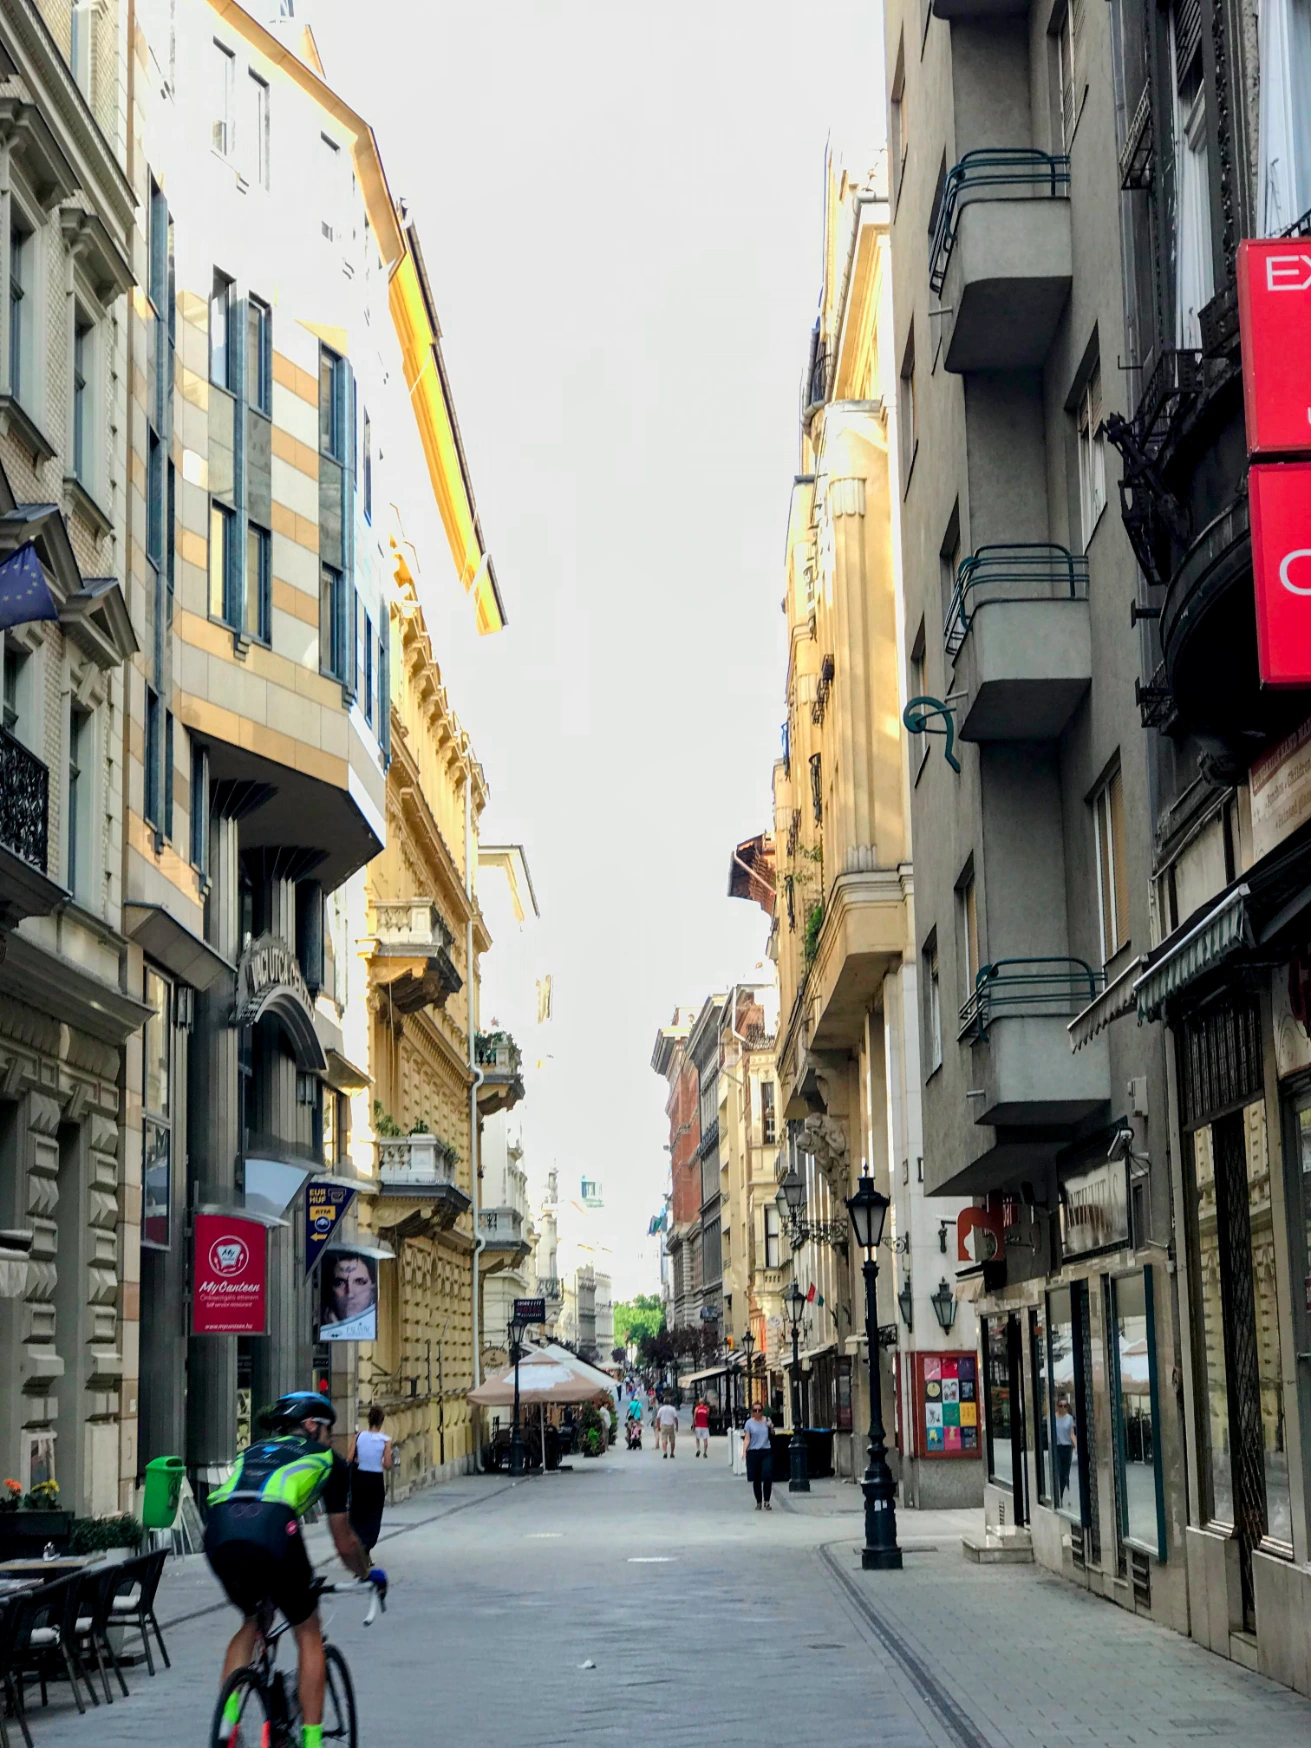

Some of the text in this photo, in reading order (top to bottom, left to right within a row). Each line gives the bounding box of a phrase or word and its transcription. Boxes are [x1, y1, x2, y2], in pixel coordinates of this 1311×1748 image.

[1266, 255, 1311, 291] E
[309, 1188, 326, 1196] EUR
[309, 1196, 326, 1204] HUF
